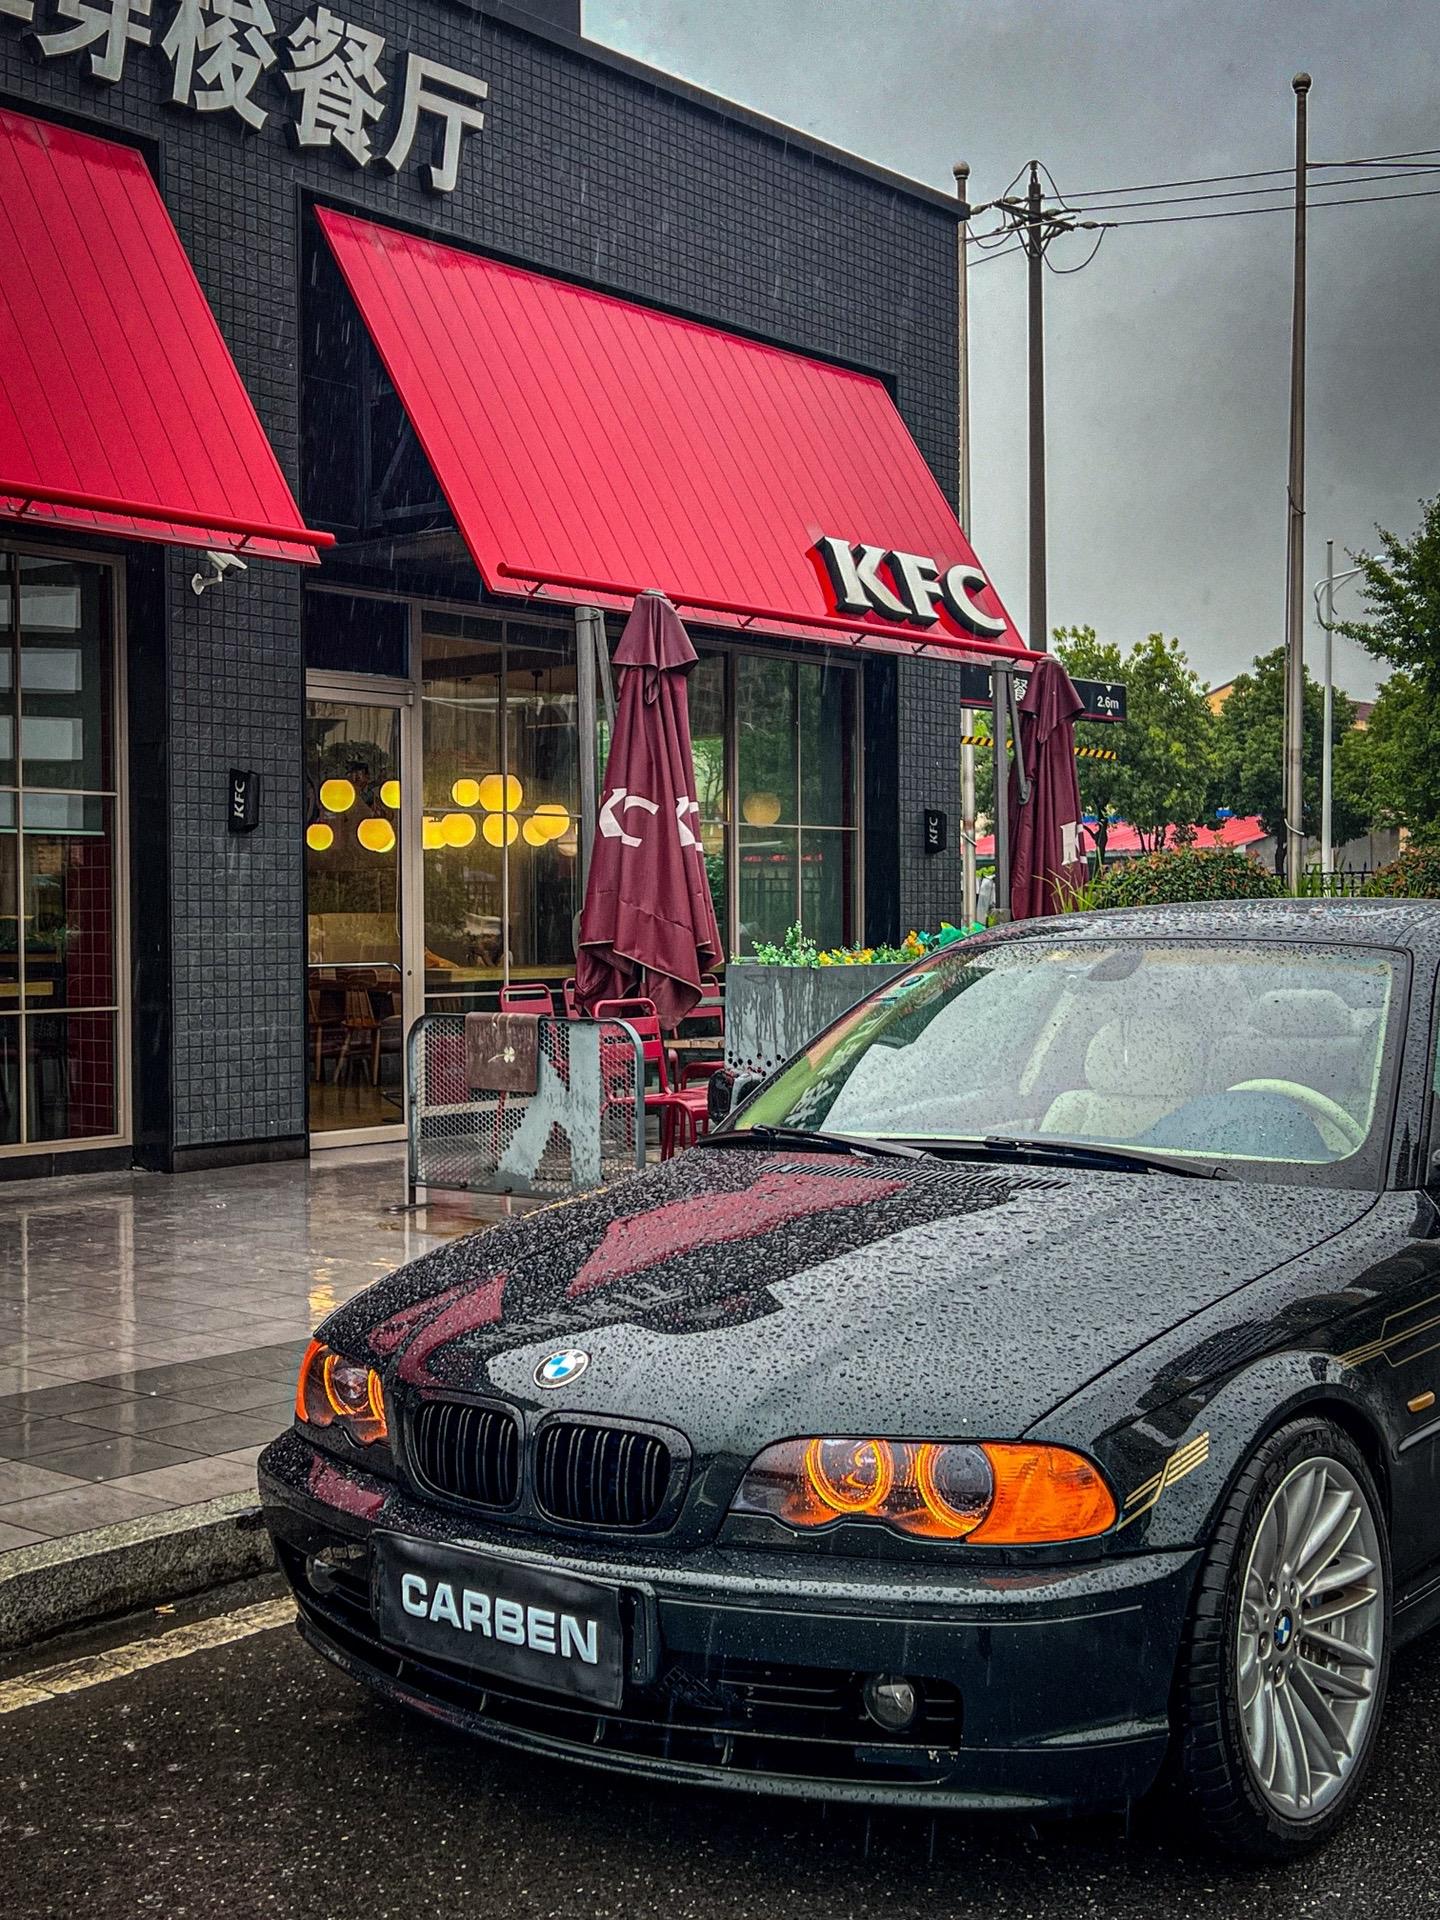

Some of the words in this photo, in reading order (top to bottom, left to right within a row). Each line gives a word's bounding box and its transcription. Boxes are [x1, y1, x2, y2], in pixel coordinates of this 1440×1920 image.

[822, 535, 1007, 634] KFC
[1096, 695, 1120, 710] 2.6m
[233, 779, 246, 819] KFC
[928, 816, 939, 845] KFC
[401, 1572, 599, 1665] CARBEN
